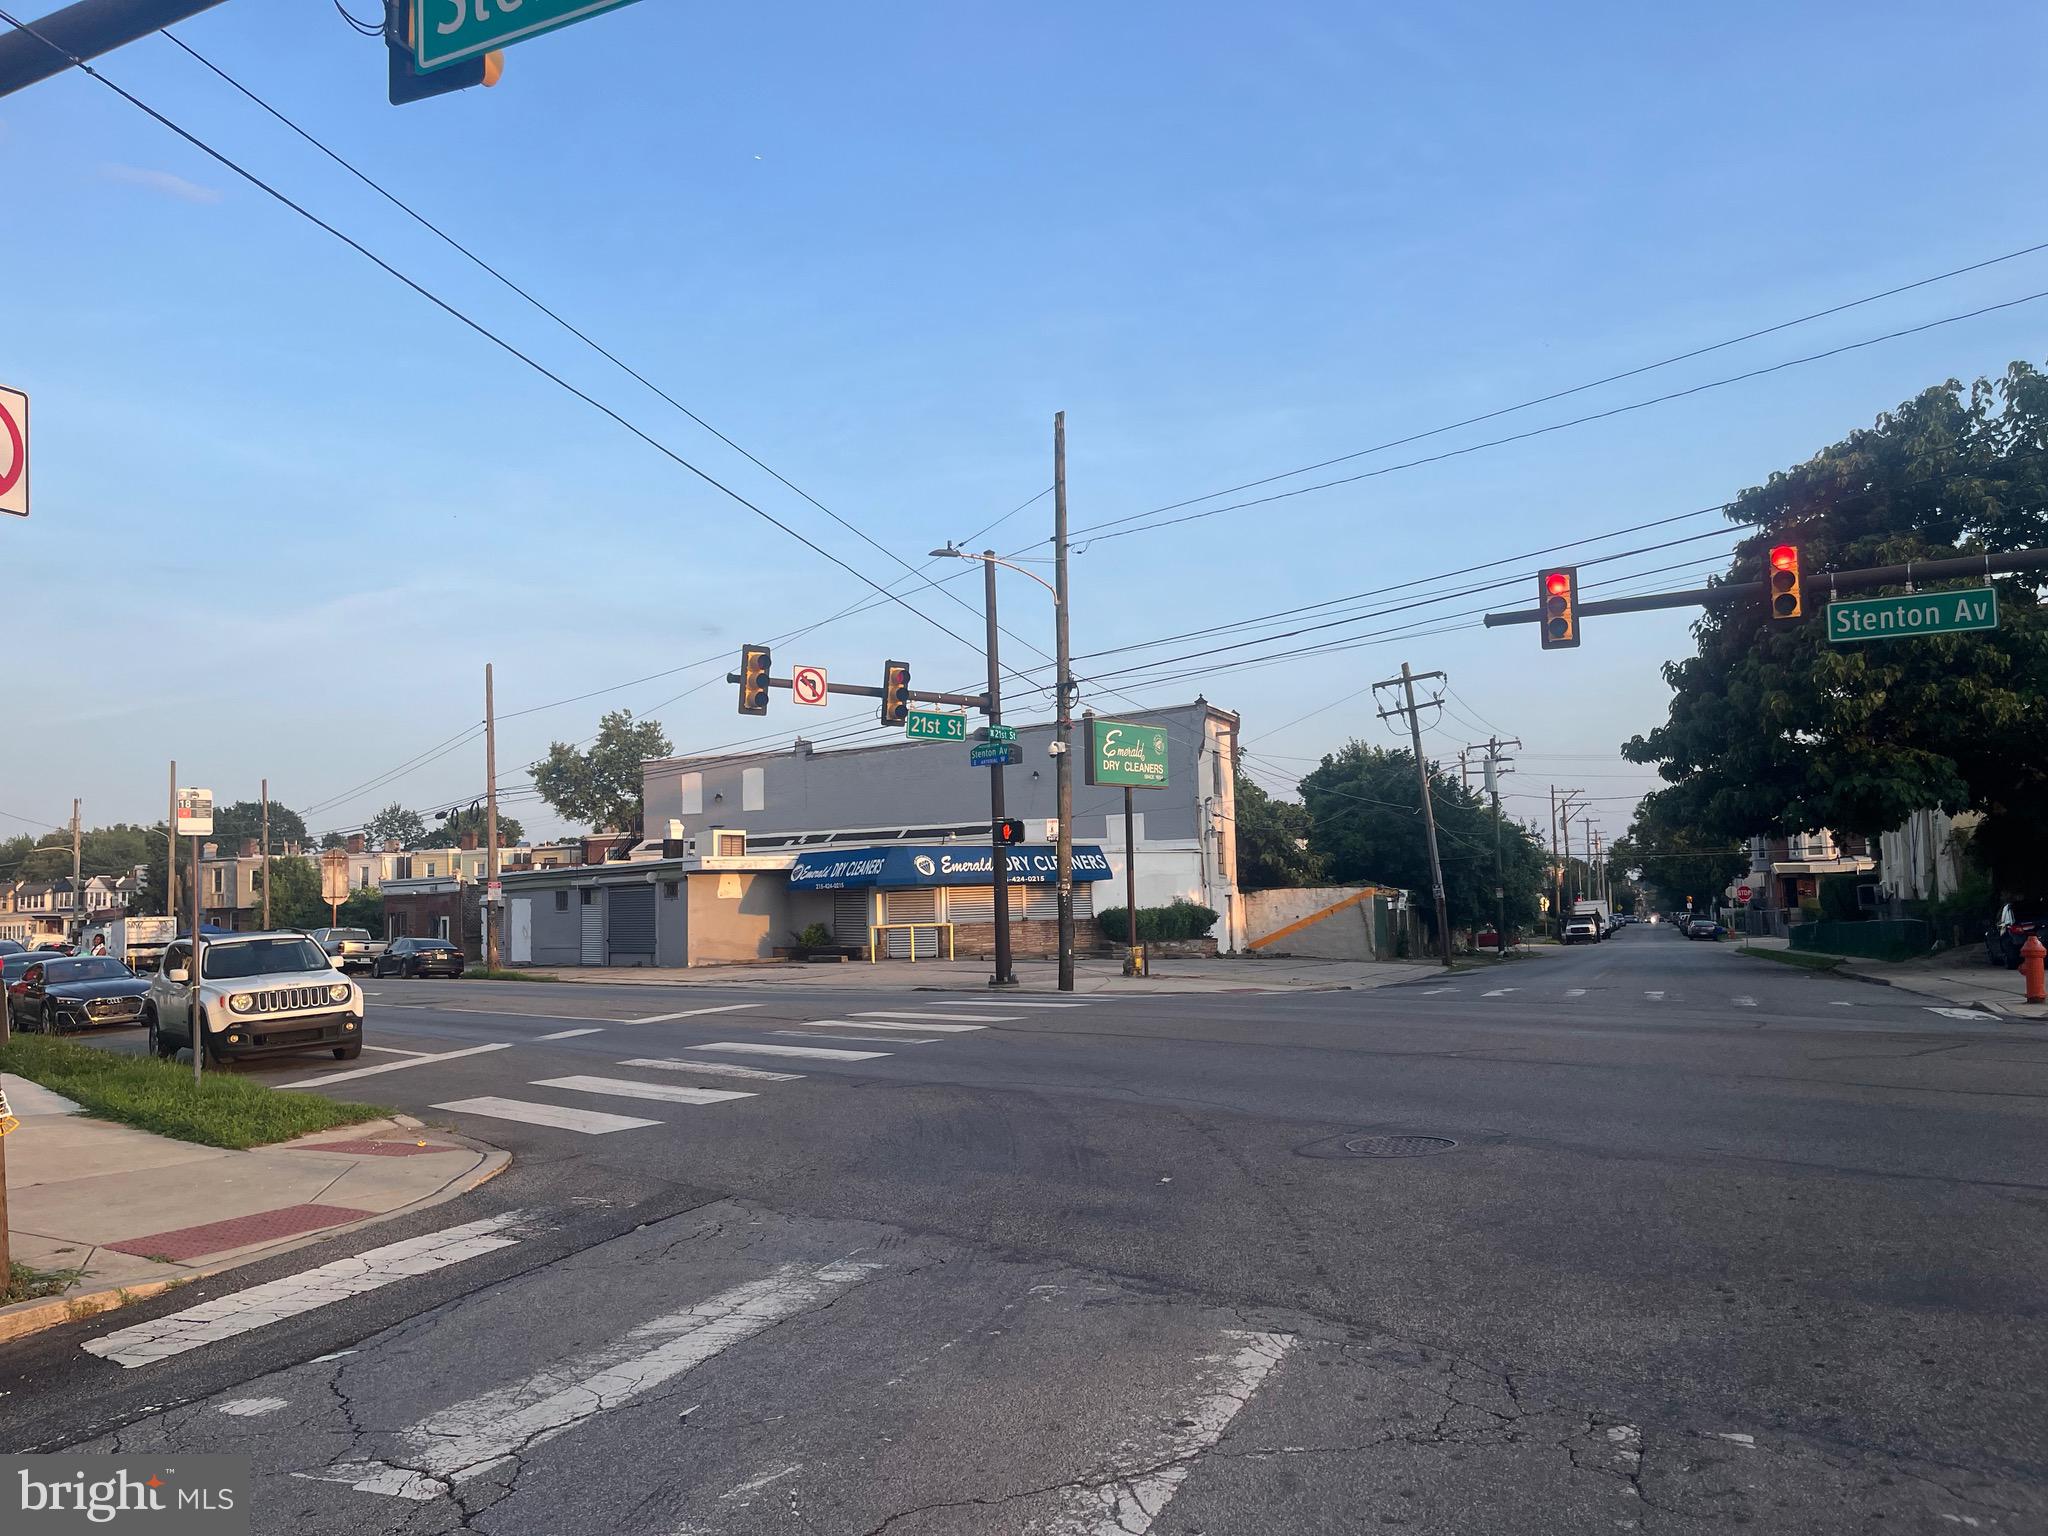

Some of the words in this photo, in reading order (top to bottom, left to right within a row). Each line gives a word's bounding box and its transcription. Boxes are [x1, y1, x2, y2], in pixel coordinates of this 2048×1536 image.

[1836, 606, 1940, 633] Stenton
[1954, 599, 1987, 623] Av
[911, 716, 941, 734] 21st
[947, 720, 962, 736] St
[995, 730, 1007, 738] 21st
[1009, 731, 1016, 740] St
[971, 750, 997, 759] Stenton
[999, 747, 1008, 755] Av
[1103, 729, 1145, 761] Emerald
[1103, 760, 1121, 771] DRY
[1124, 761, 1164, 774] CLEANERS
[180, 800, 191, 808] 18
[800, 865, 832, 880] Emerald
[830, 862, 848, 878] DRY
[846, 858, 885, 877] CLEANERS
[940, 855, 994, 874] Emerald
